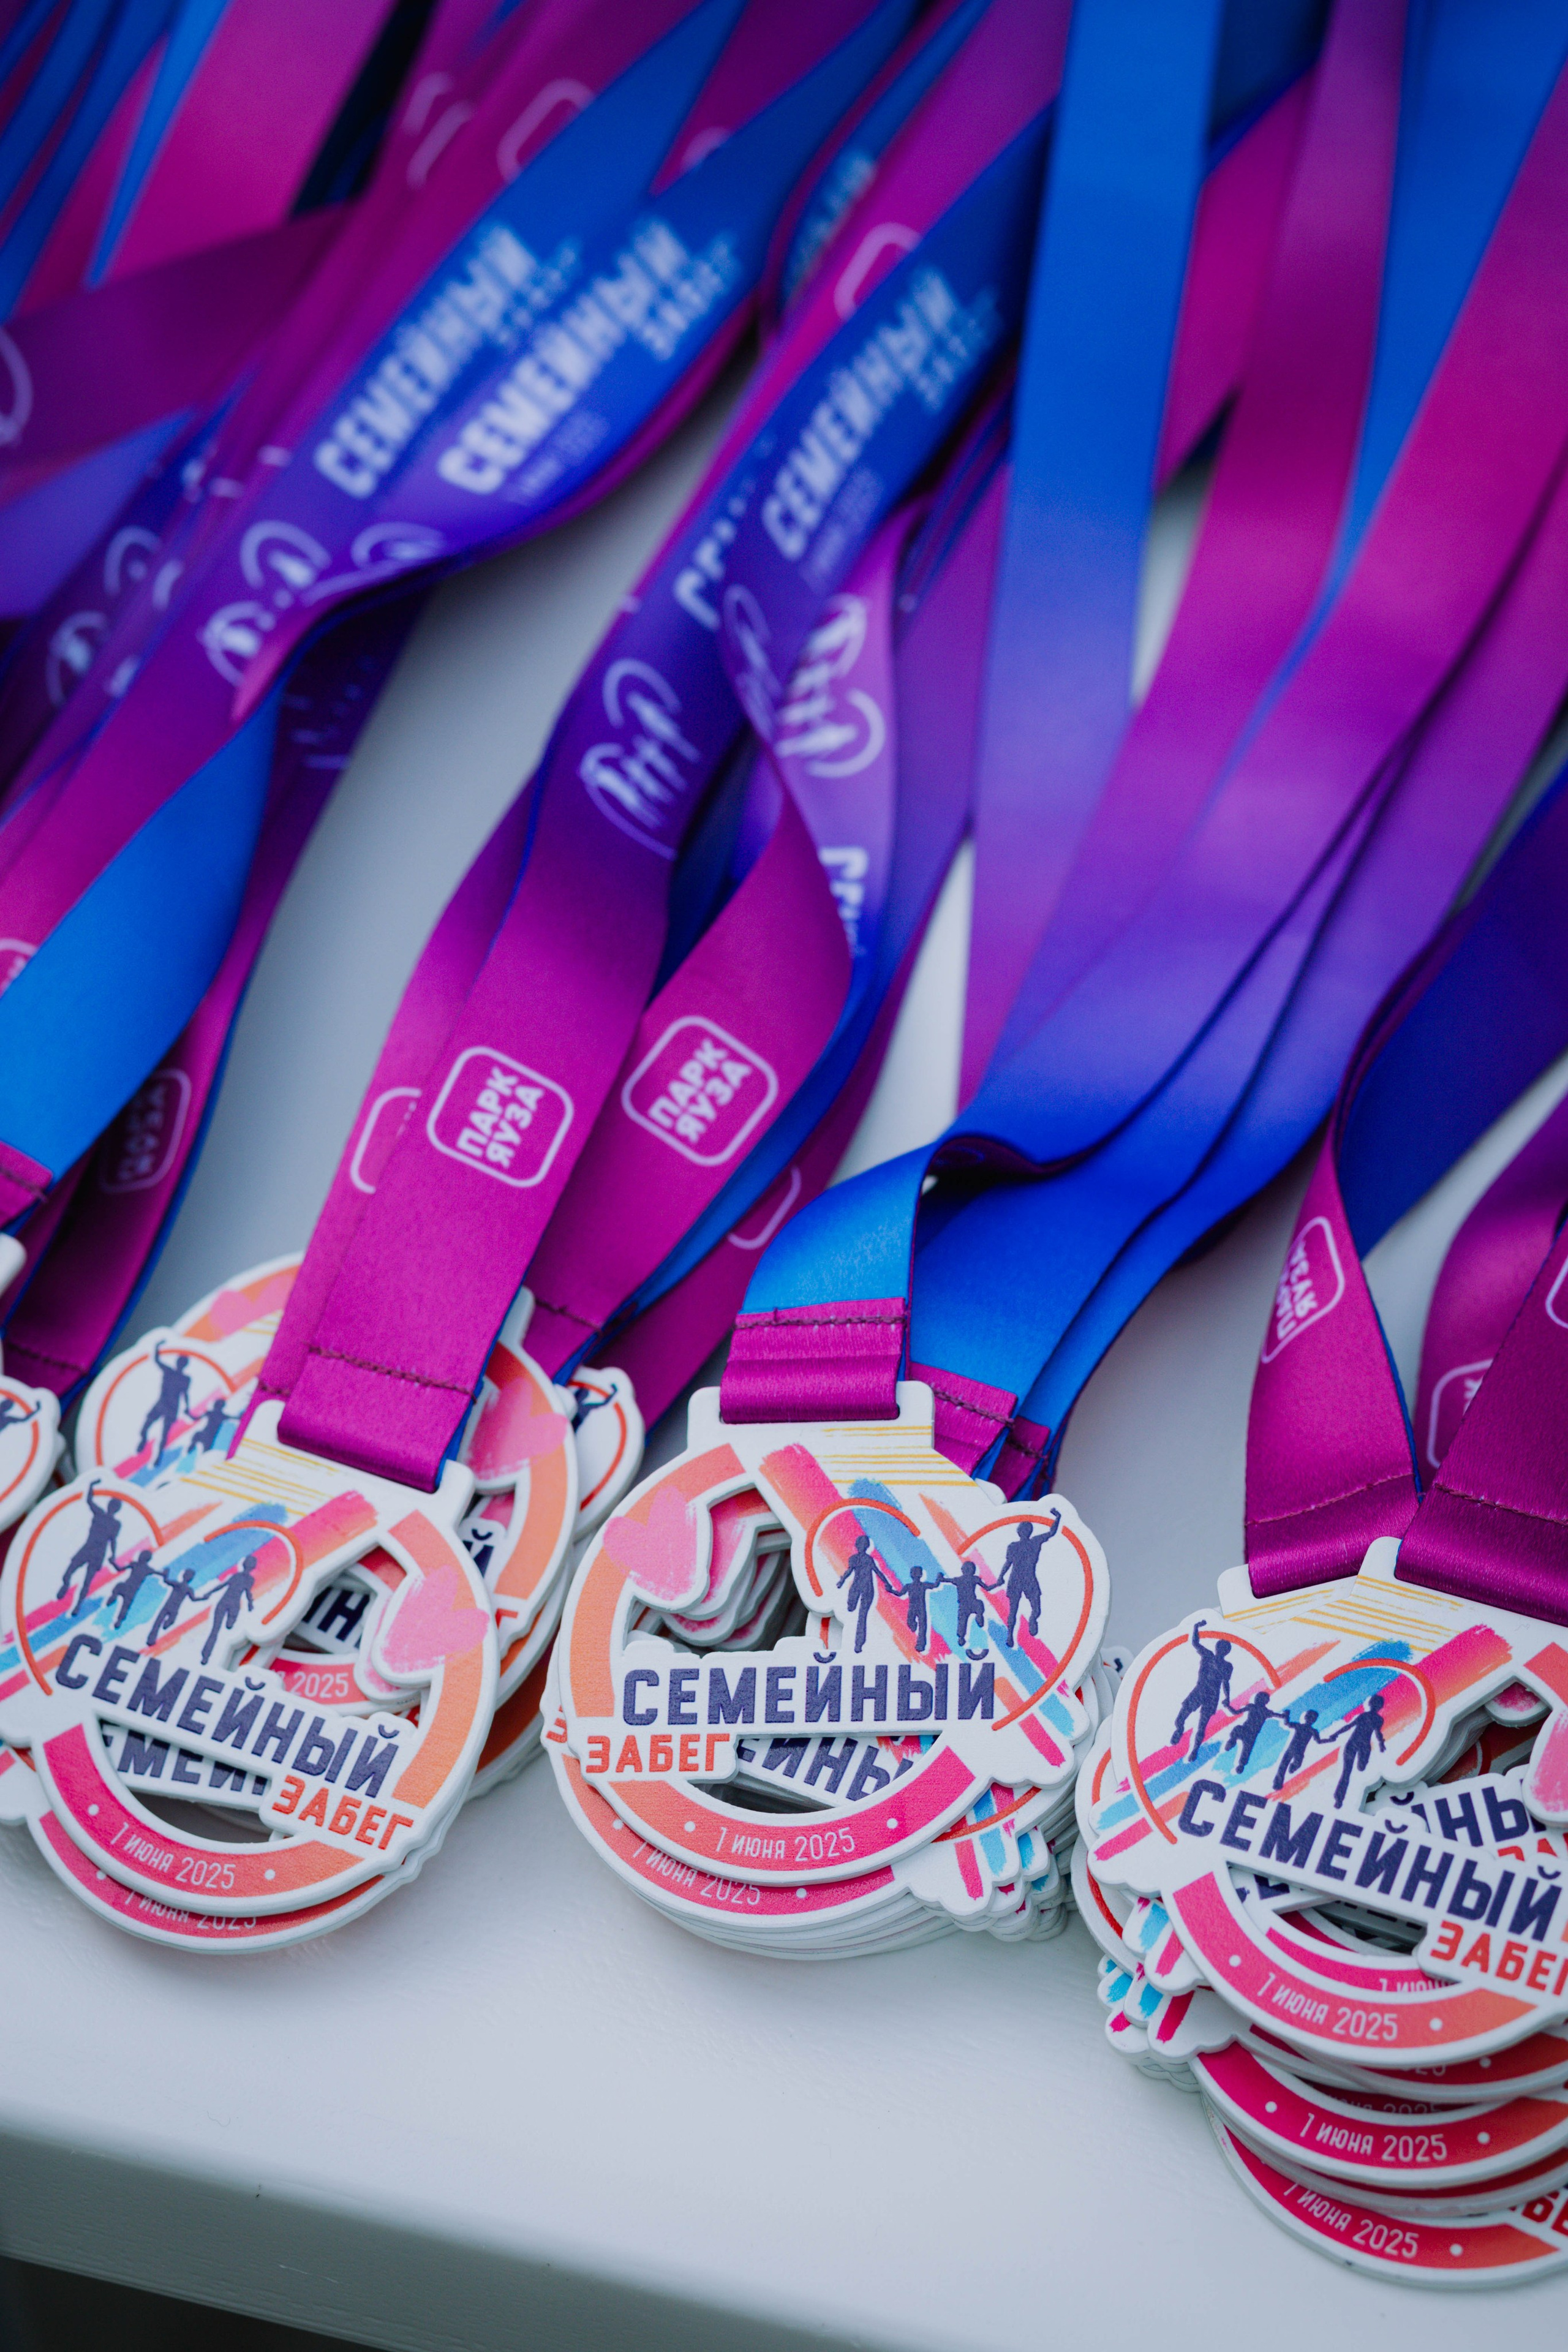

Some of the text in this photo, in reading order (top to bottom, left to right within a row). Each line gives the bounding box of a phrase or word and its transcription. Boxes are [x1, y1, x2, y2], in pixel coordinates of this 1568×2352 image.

[456, 1066, 518, 1157] ПАРК
[648, 1038, 727, 1128] ПАРК
[676, 1060, 751, 1143] ЯУЗА
[486, 1085, 544, 1168] ЯУЗА
[55, 1632, 400, 1799] СЕМЕЙНЫЙ
[290, 1672, 349, 1699] 2025
[622, 1648, 996, 1727] СЕМЕЙНЫЙ
[586, 1733, 731, 1774] ЗАБЕГ
[272, 1774, 415, 1851] ЗАБЕГ
[715, 1826, 727, 1852] 1
[794, 1827, 856, 1863] 2025
[111, 1822, 127, 1844] 1
[175, 1856, 236, 1890] 2025
[700, 1874, 761, 1905] 2025
[1178, 1779, 1562, 1942] СЕМЕЙНЫЙ
[1256, 1972, 1275, 1997] 1
[1332, 2007, 1398, 2041] 2025
[1298, 2112, 1316, 2138] 1
[1381, 2134, 1448, 2163] 2025
[1352, 2218, 1420, 2259] 2025
